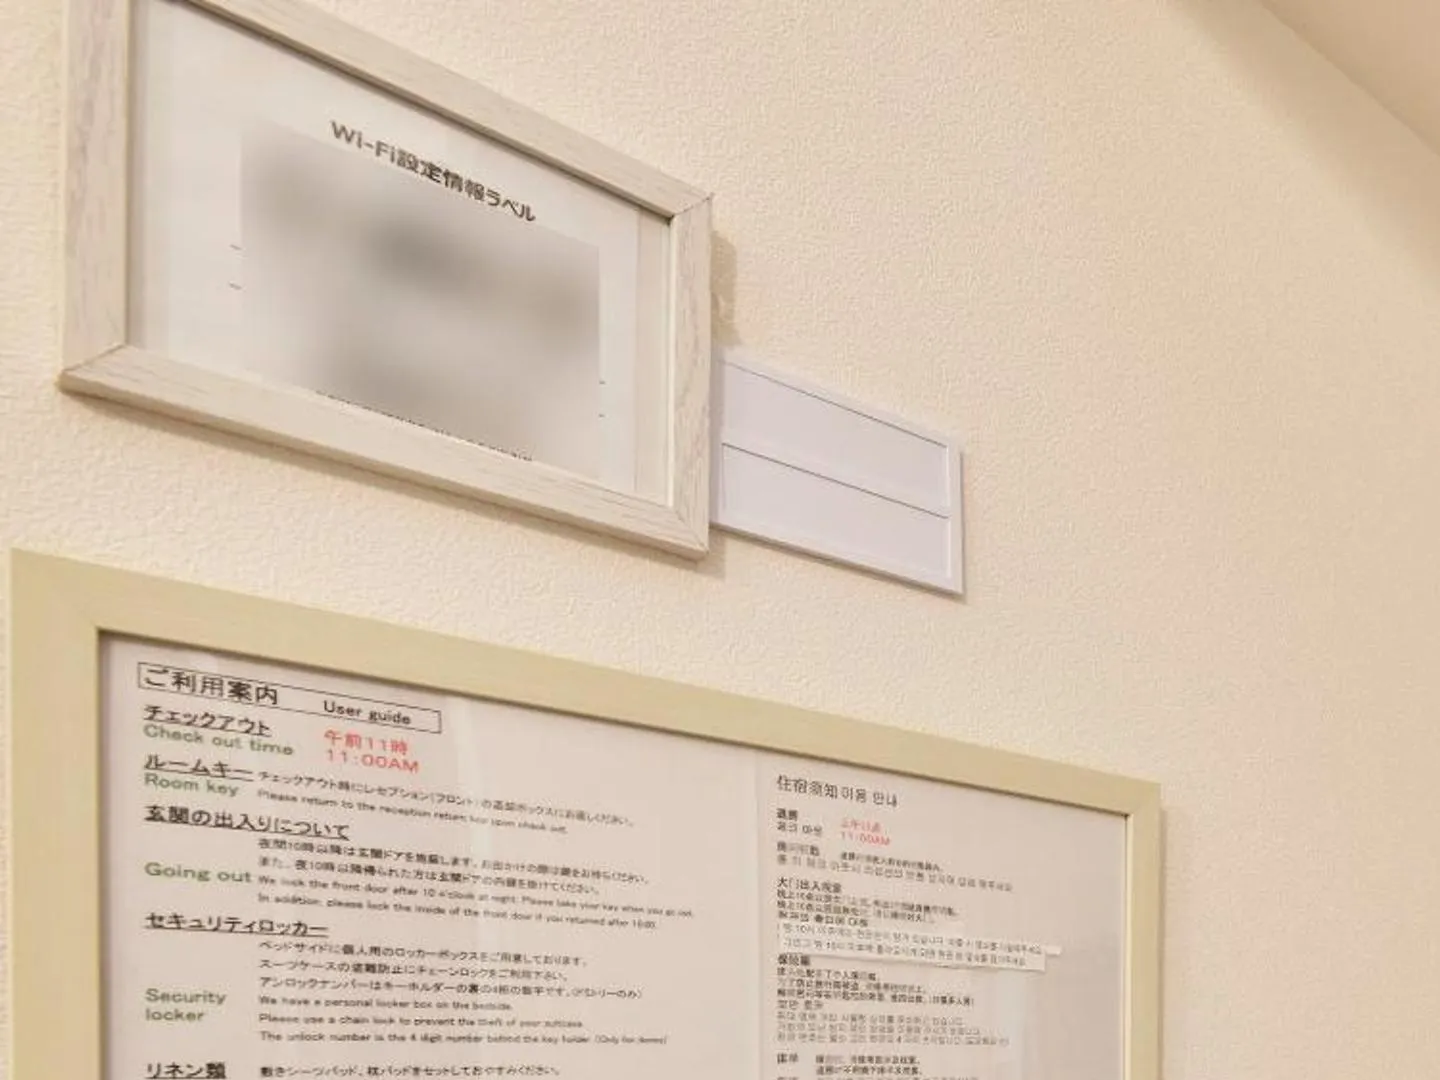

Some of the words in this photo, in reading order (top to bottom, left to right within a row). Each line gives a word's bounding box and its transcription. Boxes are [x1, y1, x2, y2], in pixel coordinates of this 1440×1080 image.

[332, 121, 537, 222] Wi-Fi設定情報ラベル
[144, 665, 278, 706] ご利用案内
[323, 700, 362, 718] User
[368, 706, 411, 728] guide
[143, 703, 272, 737] チェックアウト
[144, 722, 204, 744] Check
[211, 733, 242, 750] out
[249, 737, 293, 757] time
[323, 728, 408, 756] 午前11時
[144, 752, 252, 781] ルームキー
[326, 748, 419, 774] 11:00AM
[144, 773, 198, 792] Room
[206, 780, 239, 799] key
[357, 800, 376, 812] the
[144, 803, 350, 841] 玄関の出入りについて
[144, 862, 209, 881] Going
[217, 869, 251, 883] out
[309, 878, 328, 889] the
[145, 911, 329, 938] セキュリティロッカー
[146, 988, 226, 1005] Security
[146, 1008, 204, 1022] locker
[146, 1061, 226, 1078] リネン類
